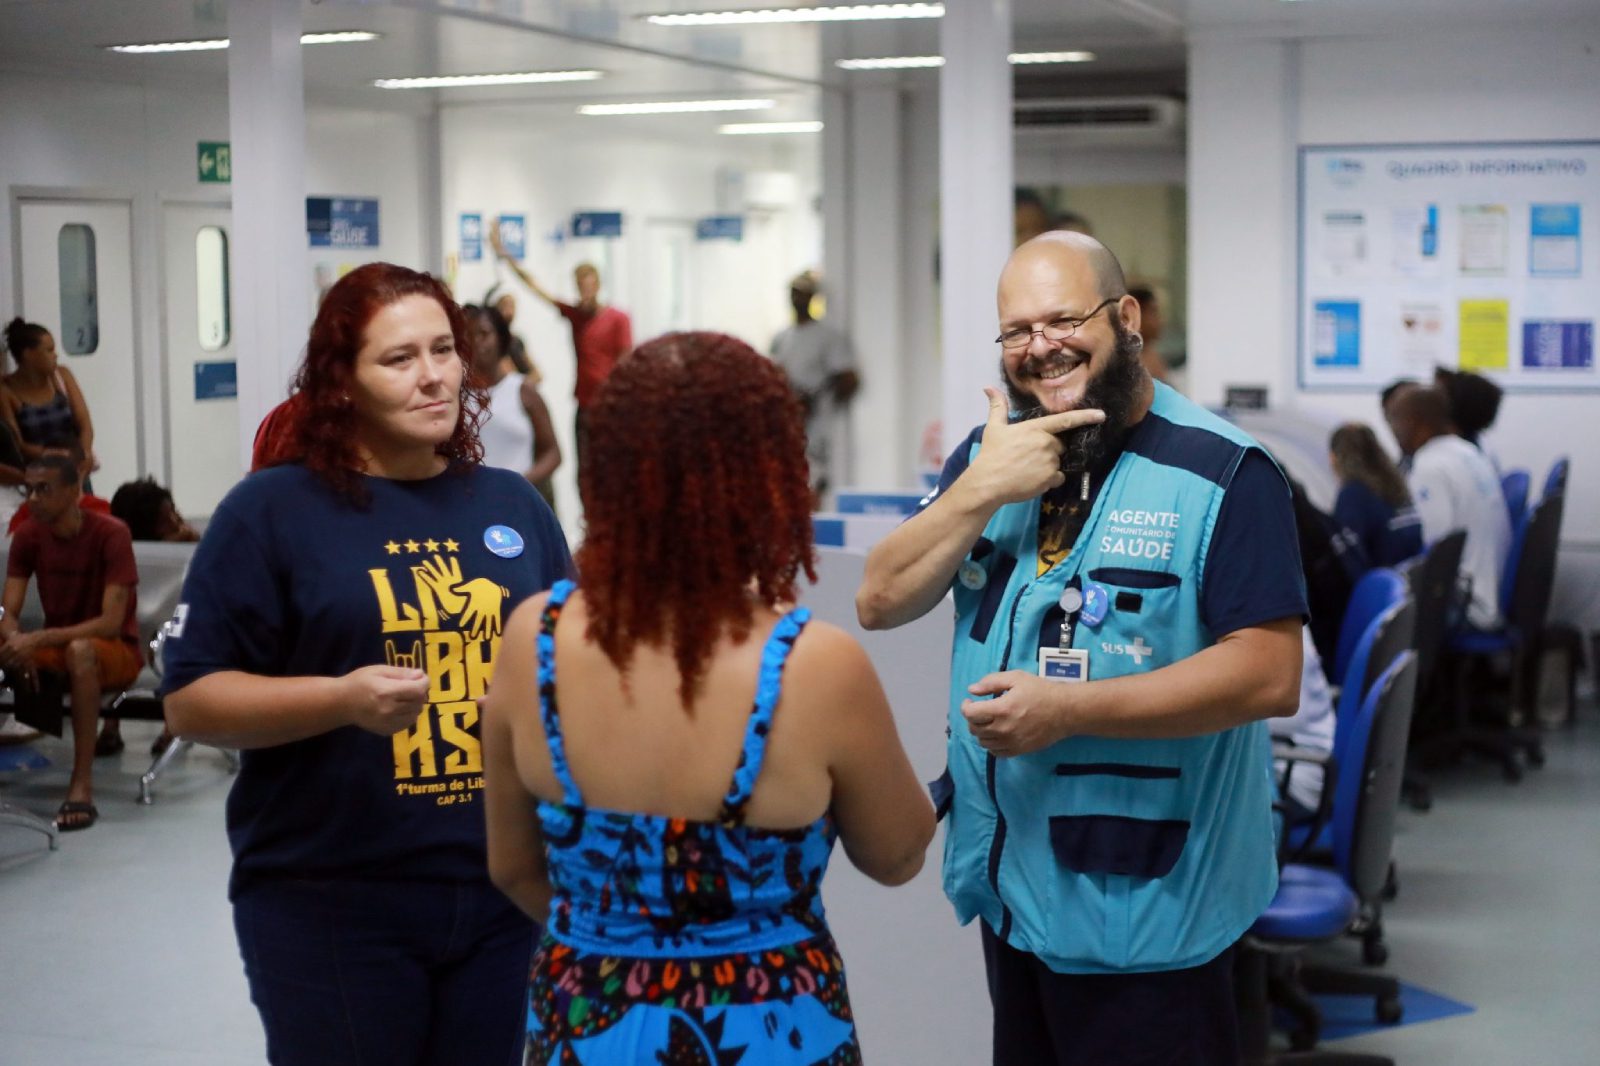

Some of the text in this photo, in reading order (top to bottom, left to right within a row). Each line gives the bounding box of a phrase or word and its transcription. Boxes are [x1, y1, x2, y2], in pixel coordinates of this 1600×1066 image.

[76, 327, 86, 348] 2
[1107, 509, 1180, 529] AGENTE
[1164, 530, 1177, 540] DE
[1099, 535, 1175, 560] SAÚDE
[1101, 642, 1125, 656] SUS
[449, 778, 465, 792] de
[436, 792, 473, 806] CAP 3.1
